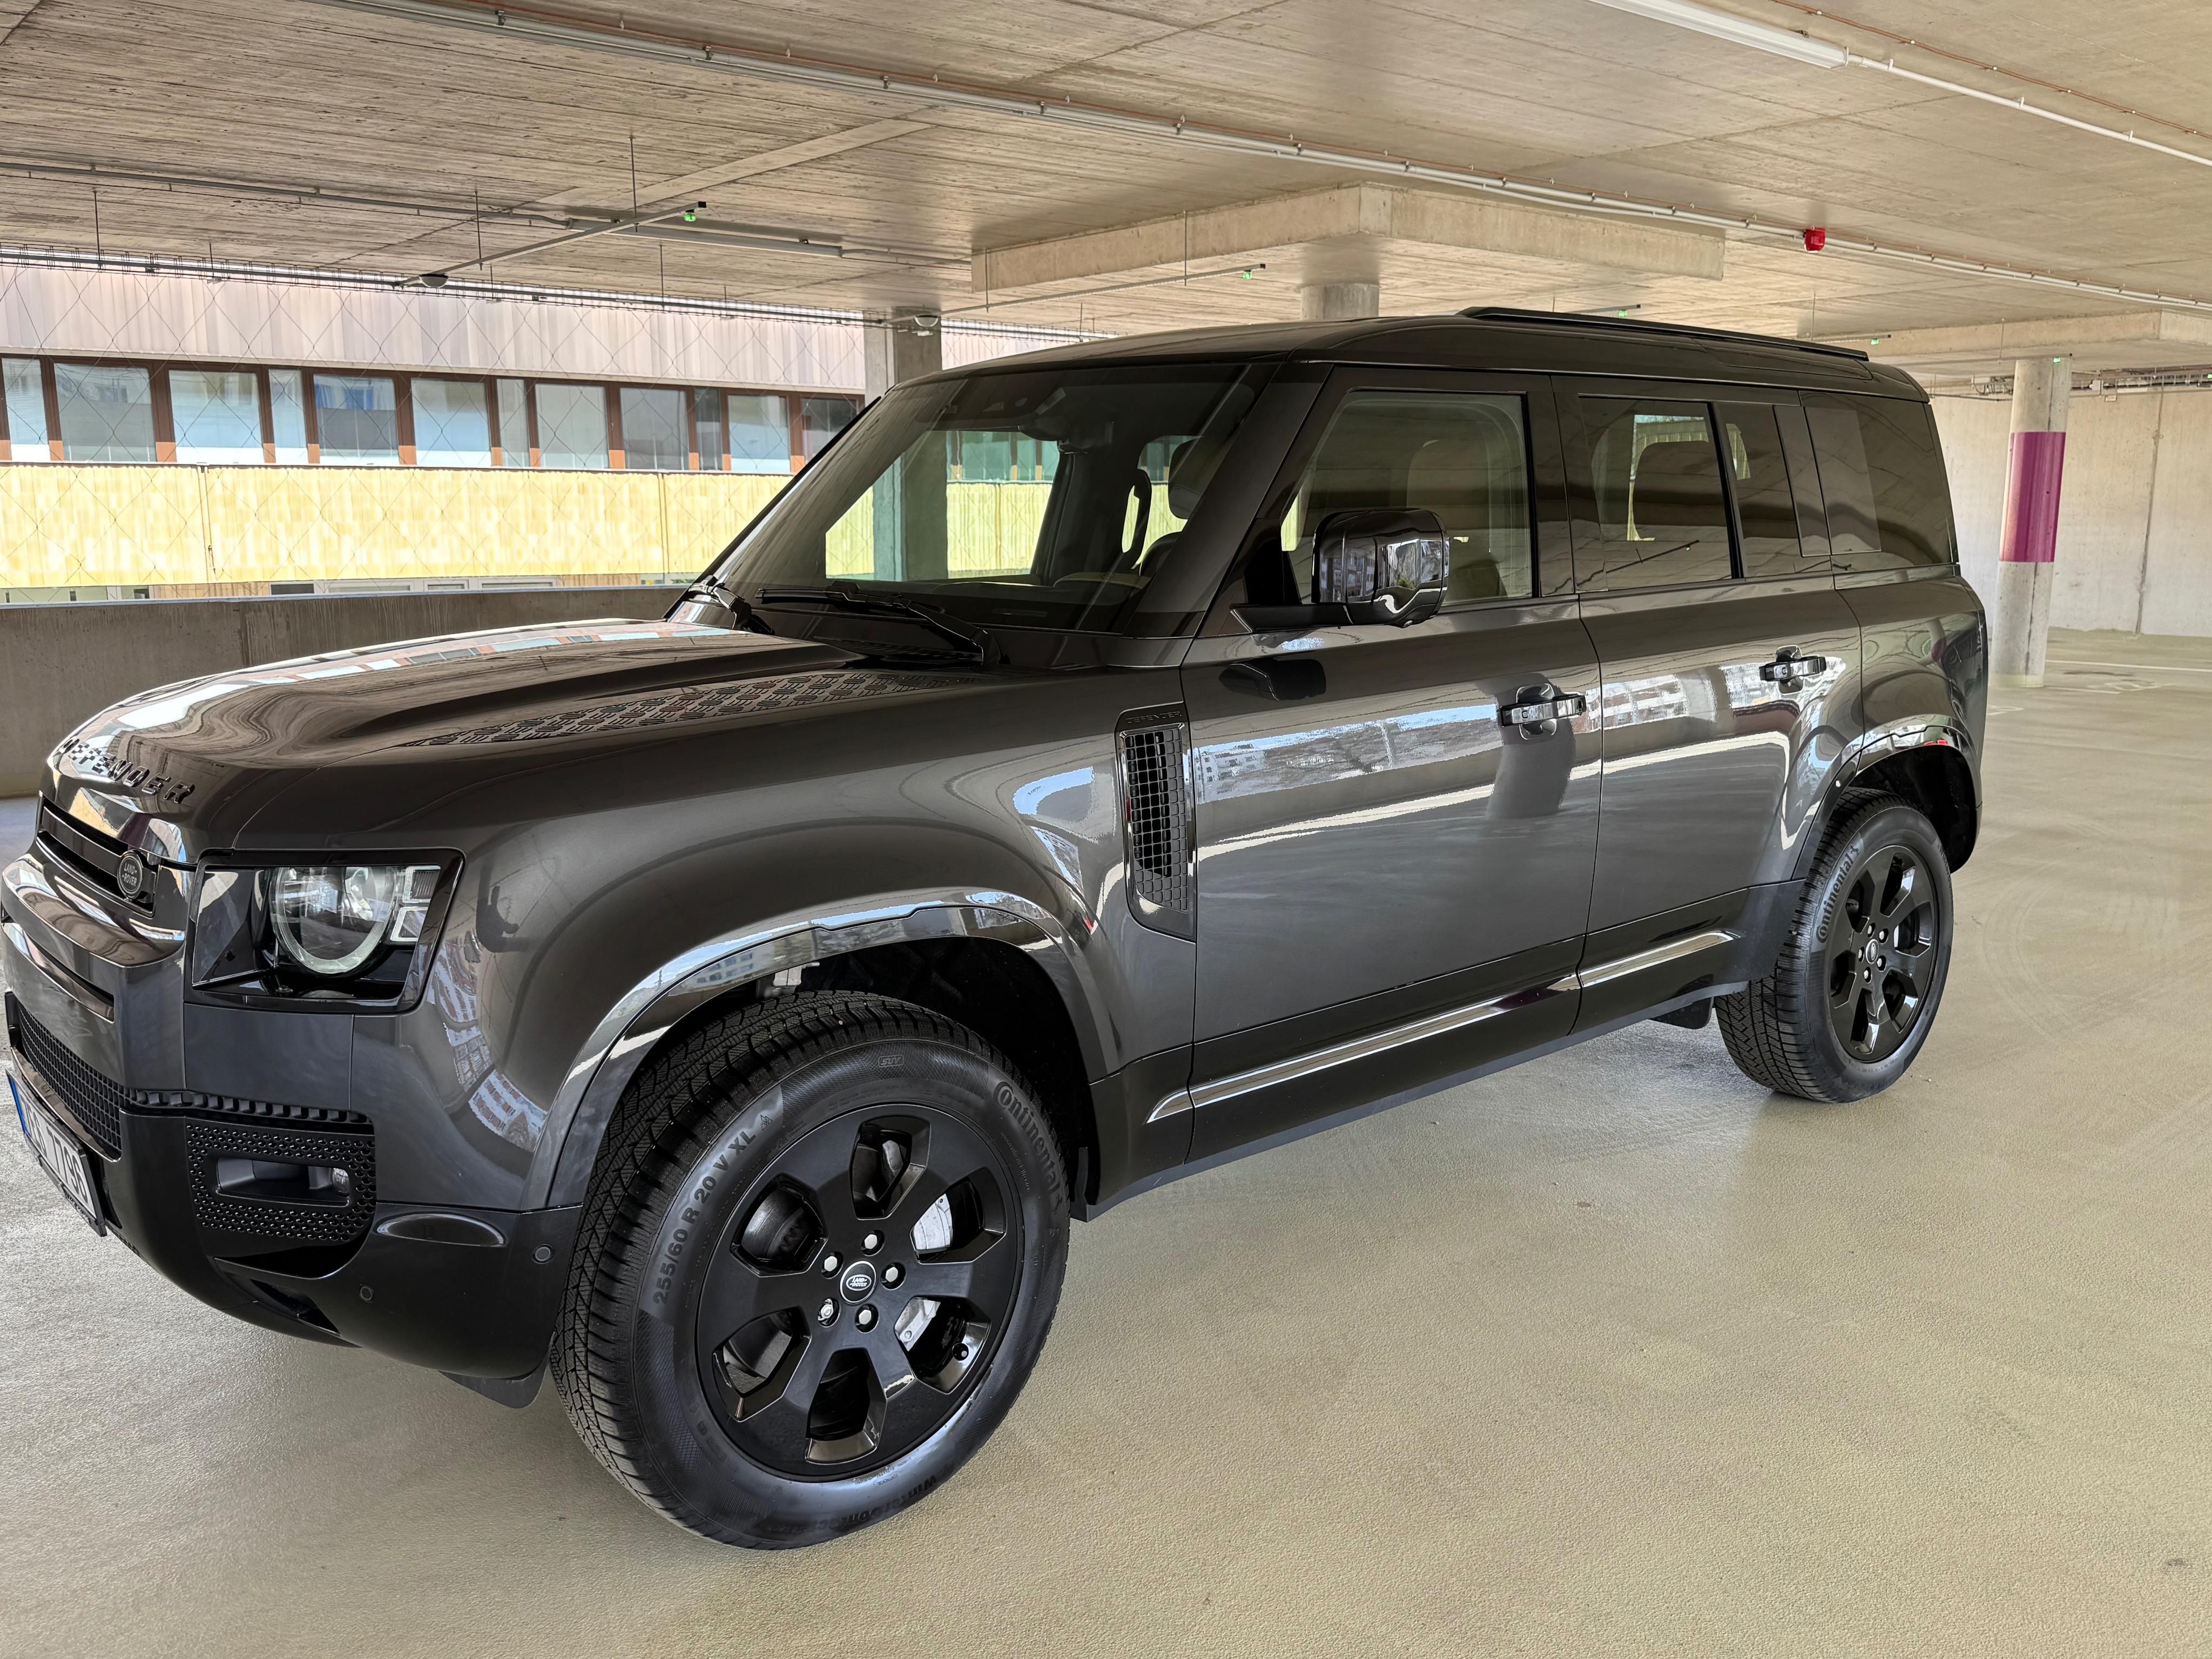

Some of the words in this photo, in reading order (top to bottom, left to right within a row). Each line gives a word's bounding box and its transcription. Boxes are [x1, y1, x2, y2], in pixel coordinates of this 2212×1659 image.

[1125, 711, 1182, 723] DEFENDER
[60, 738, 195, 804] DEFENDER
[124, 862, 135, 875] LAND
[124, 873, 137, 887] ROVER
[1816, 853, 1853, 943] Continental
[881, 1056, 901, 1065] SUV
[46, 1125, 89, 1204] 7796
[993, 1081, 1060, 1194] Continental
[653, 1228, 689, 1304] 255/60
[680, 1207, 700, 1224] R
[694, 1176, 717, 1204] 20
[713, 1154, 730, 1171] V
[727, 1131, 757, 1156] XL
